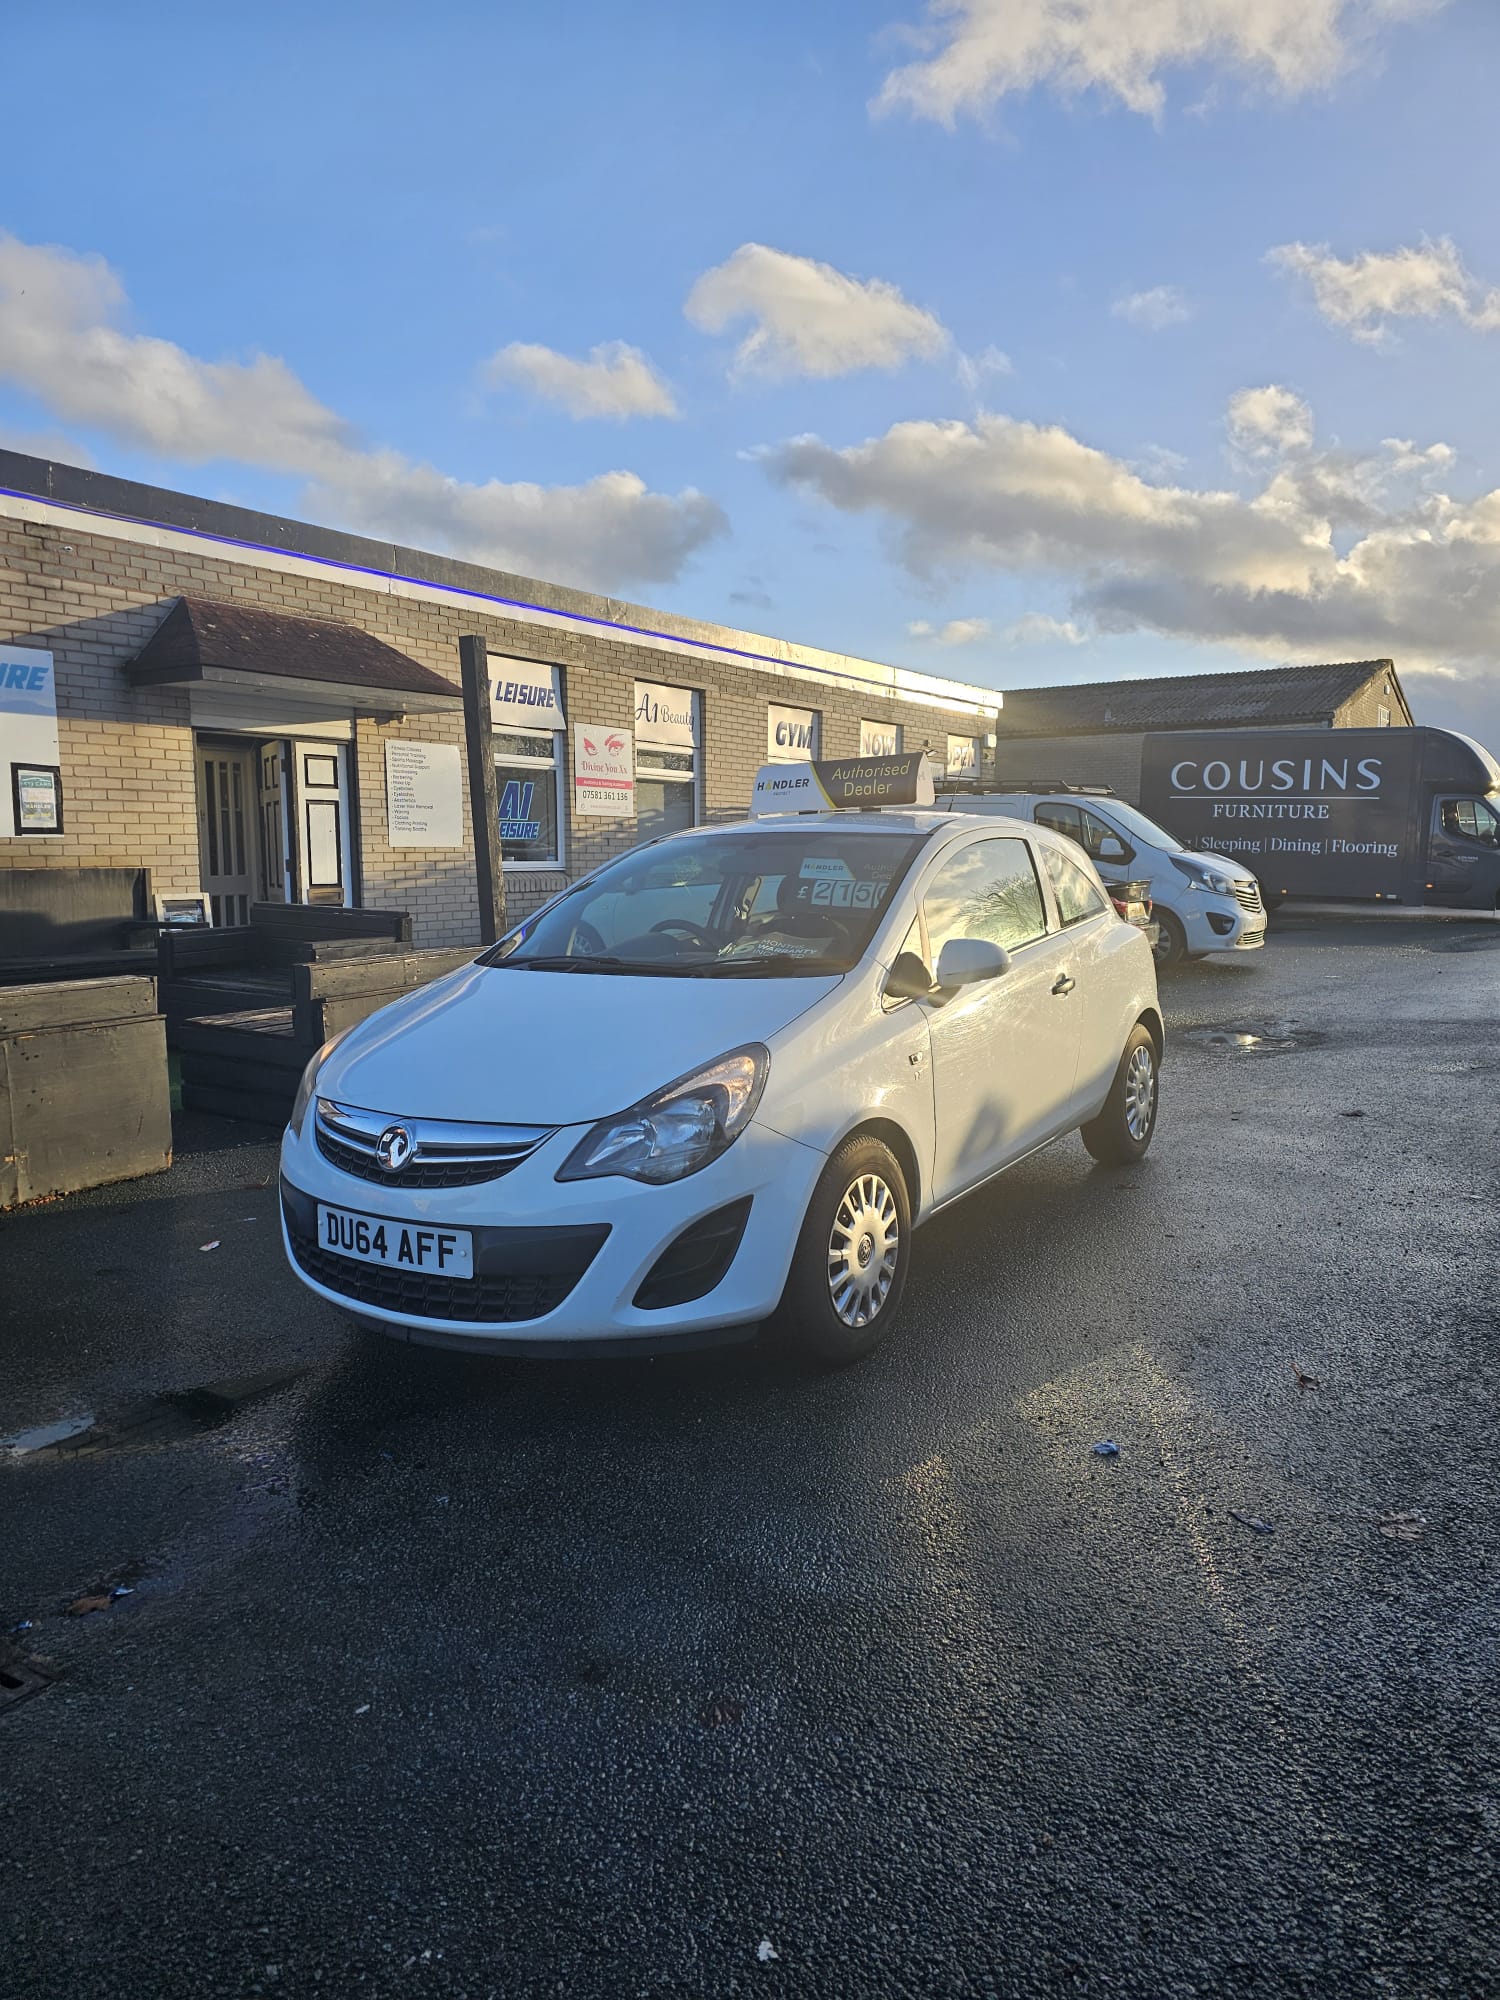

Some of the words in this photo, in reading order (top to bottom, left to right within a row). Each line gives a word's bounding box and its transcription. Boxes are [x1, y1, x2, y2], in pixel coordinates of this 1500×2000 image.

[496, 681, 555, 708] LEISURE
[636, 693, 658, 722] A1
[661, 705, 694, 732] Beauty
[776, 721, 813, 749] GYM
[862, 732, 895, 756] NOW
[832, 760, 910, 780] Authorised
[1171, 759, 1382, 791] COUSINS
[583, 791, 602, 799] 07581
[604, 792, 615, 800] 361
[844, 780, 892, 797] Dealer
[1213, 804, 1329, 819] FURNITURE
[500, 822, 540, 839] EISURE
[1201, 837, 1260, 852] Sleeping
[1271, 838, 1321, 854] Dining
[1332, 839, 1398, 857] Flooring
[327, 1212, 388, 1259] DU64
[398, 1229, 456, 1268] AFF
